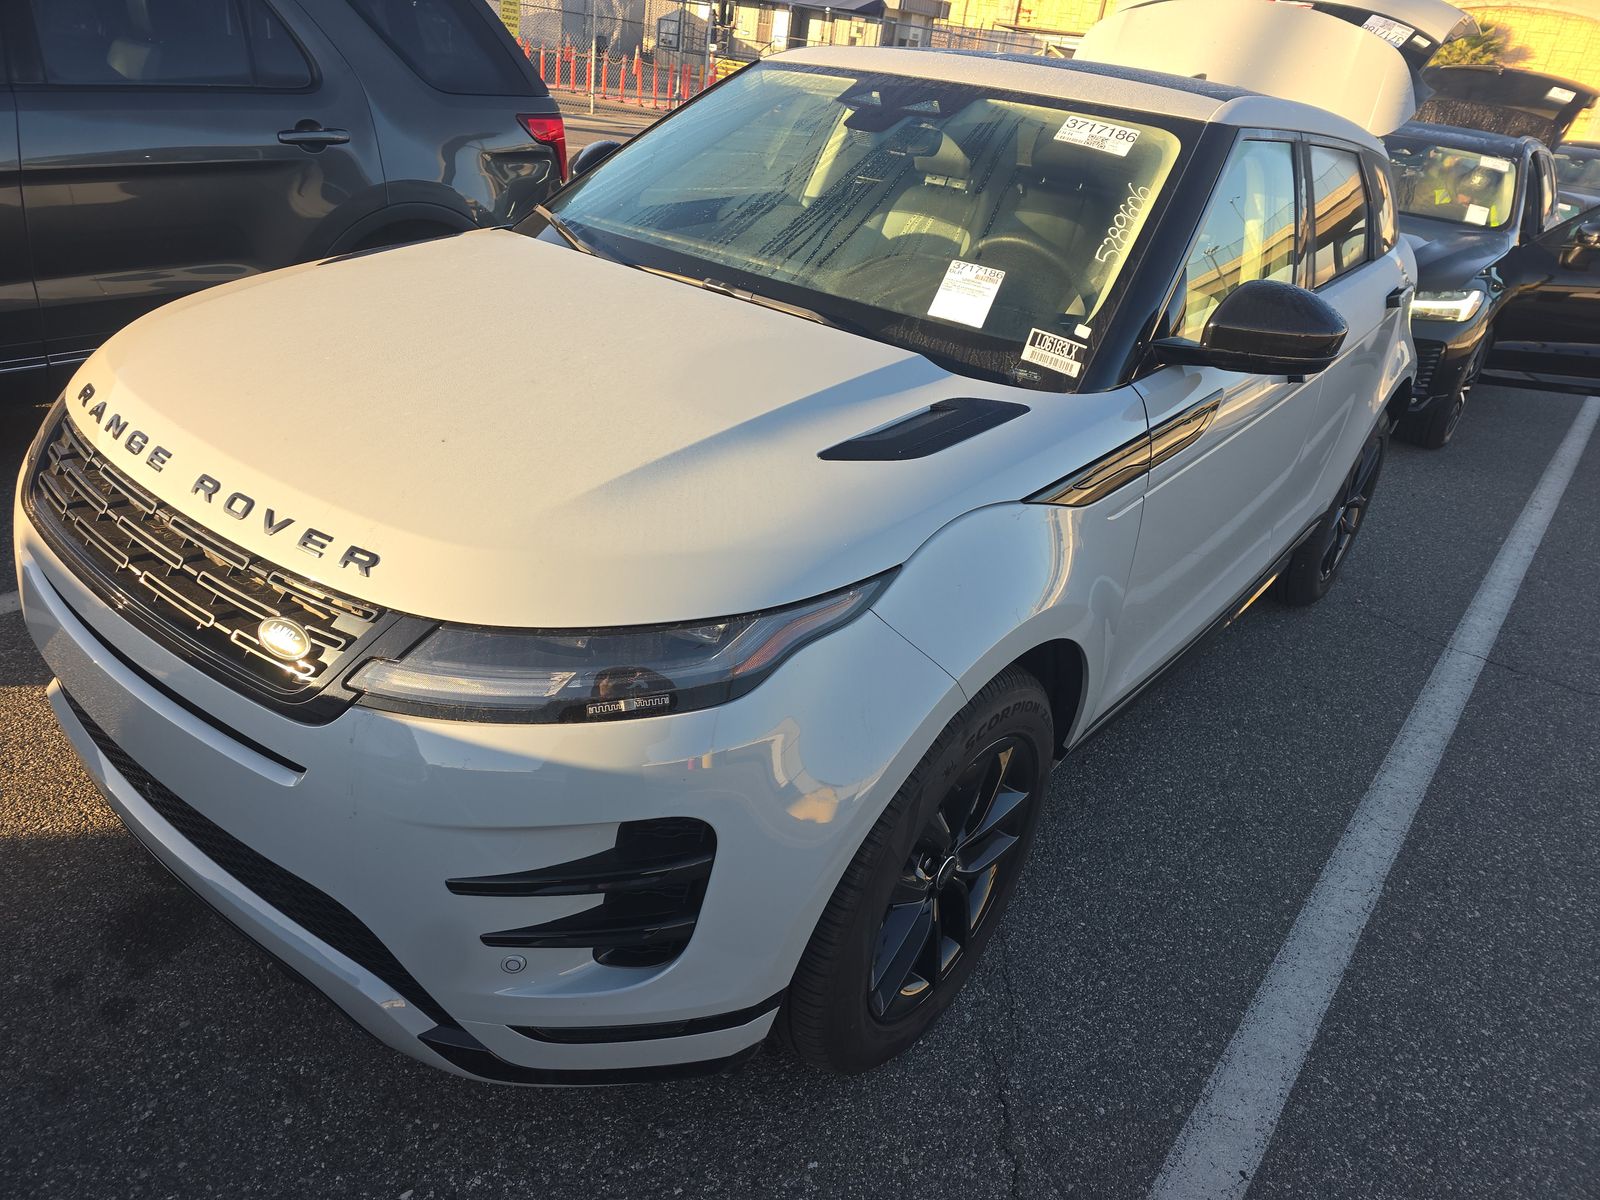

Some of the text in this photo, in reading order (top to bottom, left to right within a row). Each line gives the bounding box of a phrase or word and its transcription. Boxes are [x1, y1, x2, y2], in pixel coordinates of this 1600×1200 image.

[1066, 118, 1138, 143] 3717186
[953, 261, 1005, 280] 3717186
[1034, 333, 1079, 361] L06183LX
[77, 382, 381, 577] RANGE ROVER
[965, 700, 1041, 751] SCORPION
